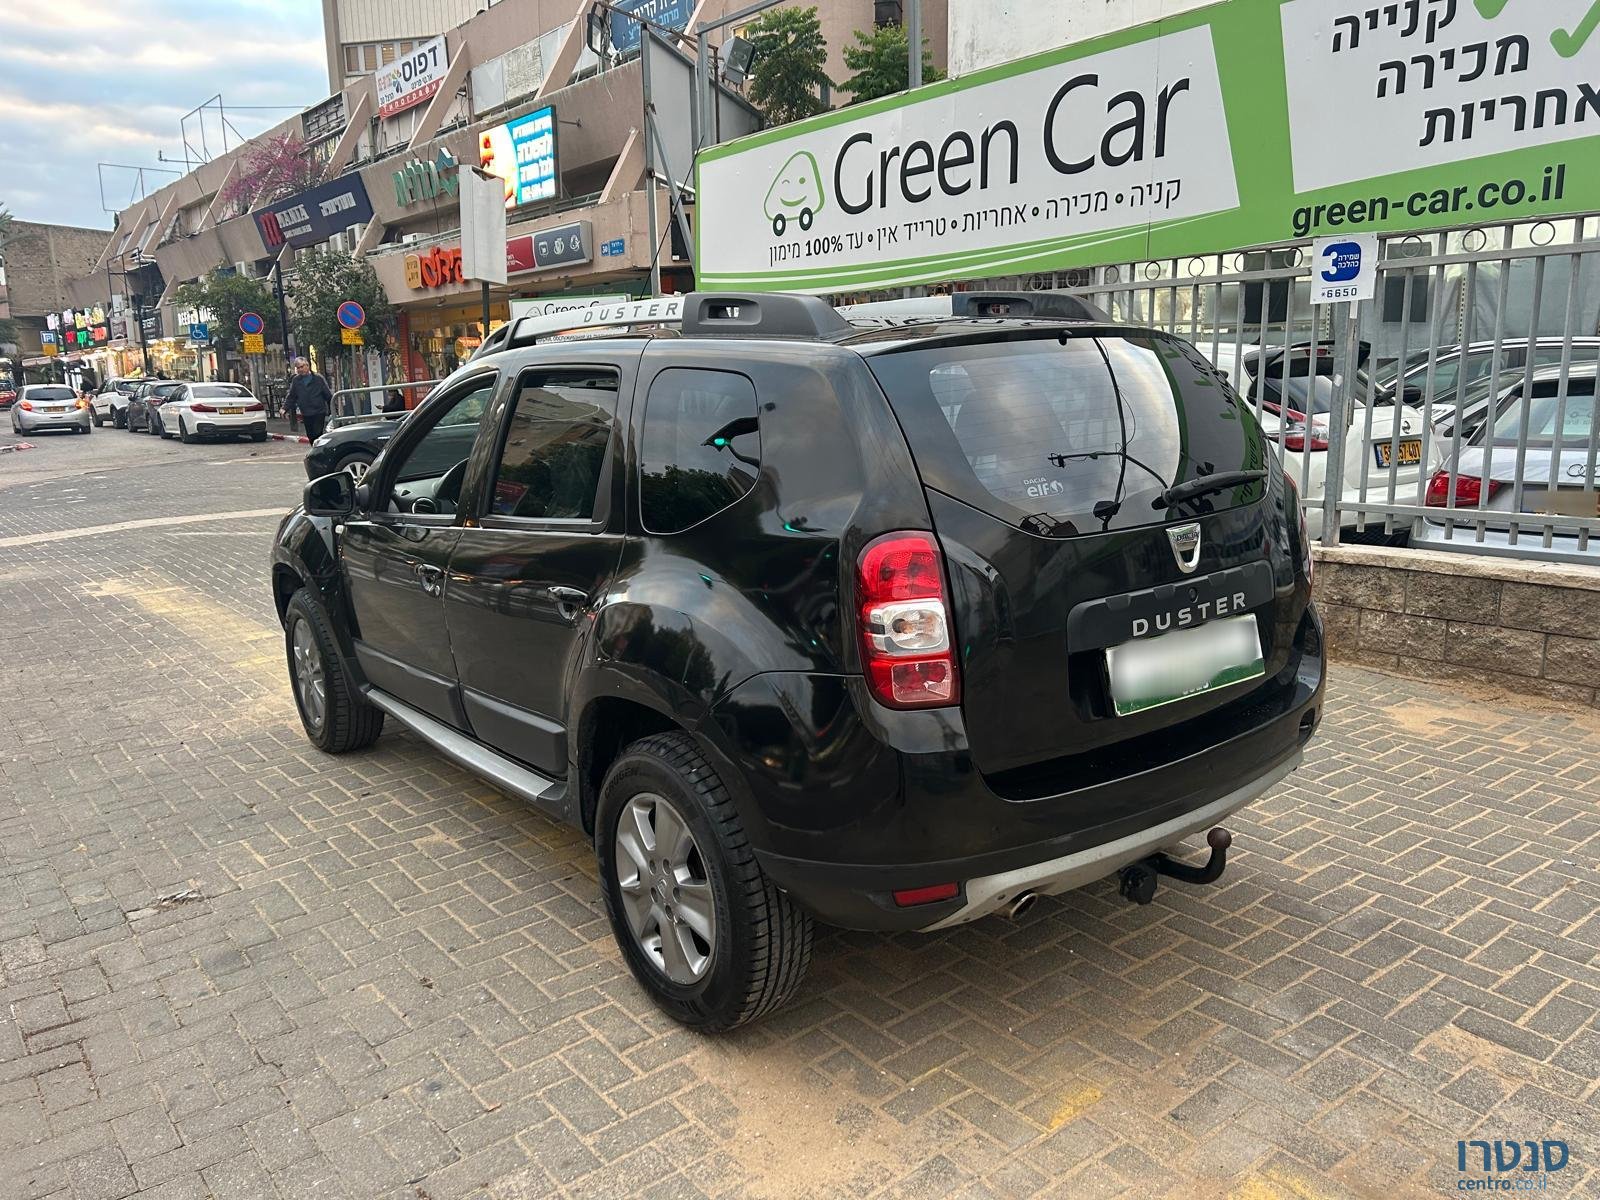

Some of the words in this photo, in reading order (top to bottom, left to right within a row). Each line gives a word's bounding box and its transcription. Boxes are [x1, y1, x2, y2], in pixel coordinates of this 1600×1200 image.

[1331, 0, 1457, 53] קנייה
[401, 45, 438, 83] דפוס
[1376, 33, 1530, 98] מכירה
[1419, 82, 1600, 147] אחריות
[834, 120, 1019, 215] Green
[1043, 73, 1190, 175] Car
[1045, 192, 1108, 221] מכירה
[1129, 178, 1182, 211] קניה
[1292, 164, 1567, 238] green-car.co.il
[903, 216, 946, 240] טרייד
[962, 203, 1027, 233] אחריות
[805, 235, 843, 257] 100%
[847, 232, 864, 251] עד
[877, 224, 898, 252] אין
[769, 240, 801, 267] מימון
[1338, 253, 1360, 261] שמירה
[584, 302, 678, 323] DUSTER
[1027, 482, 1050, 497] elf
[1132, 591, 1247, 638] DUSTER
